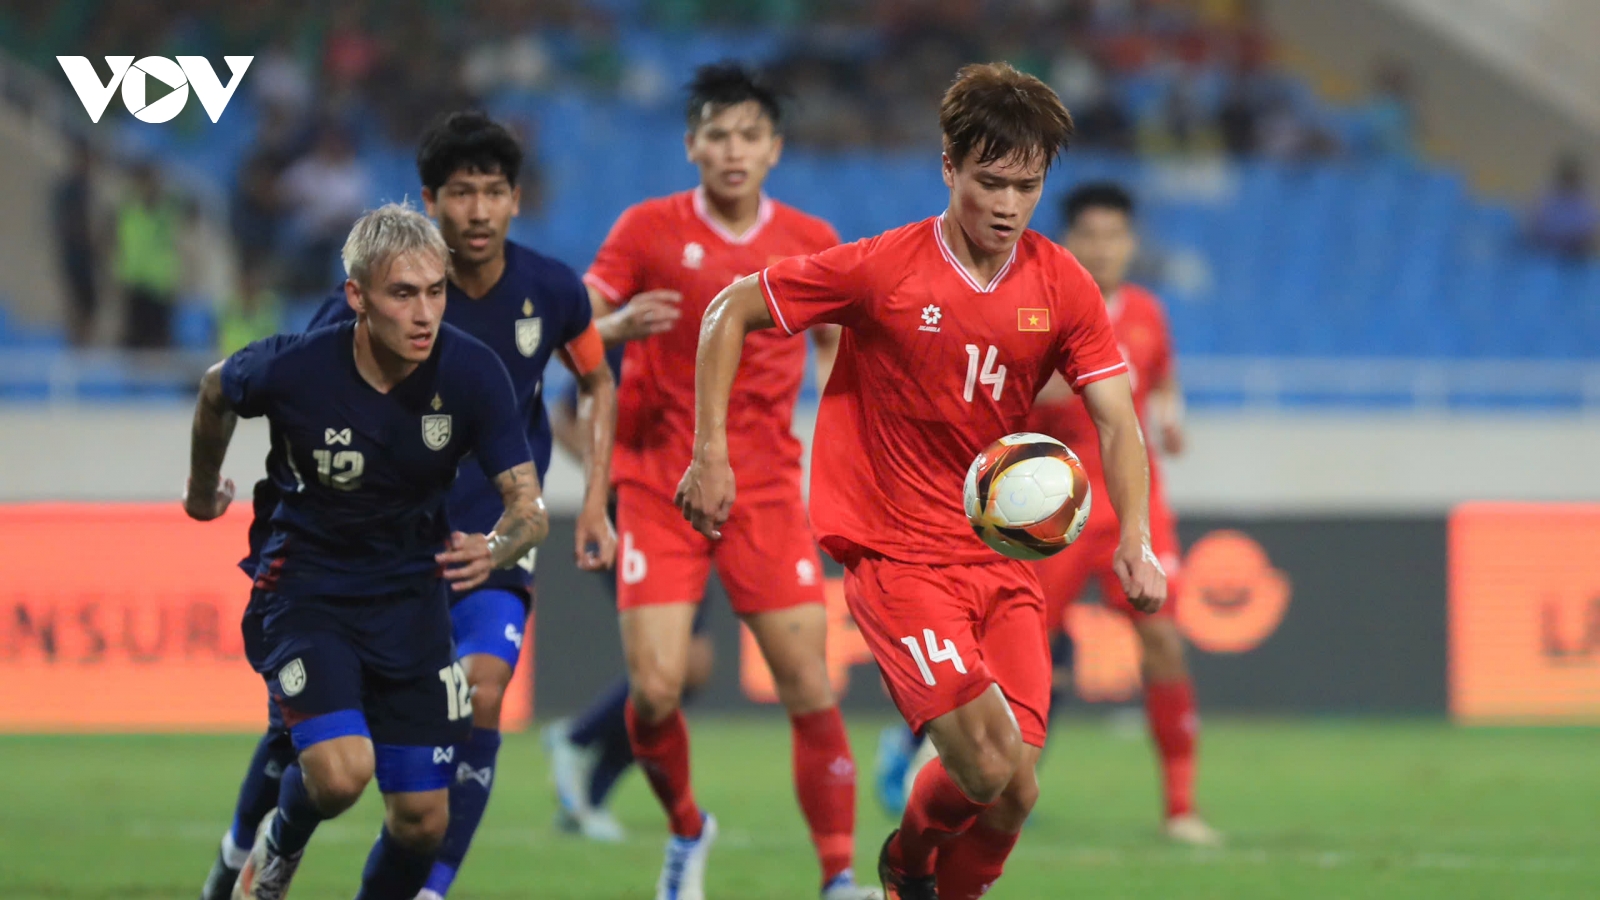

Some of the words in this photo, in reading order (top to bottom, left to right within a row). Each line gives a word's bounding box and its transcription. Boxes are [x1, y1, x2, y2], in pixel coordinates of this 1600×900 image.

[962, 343, 1008, 403] 14
[312, 449, 365, 492] 12
[621, 531, 648, 585] 6
[900, 628, 968, 687] 14
[438, 661, 473, 722] 12
